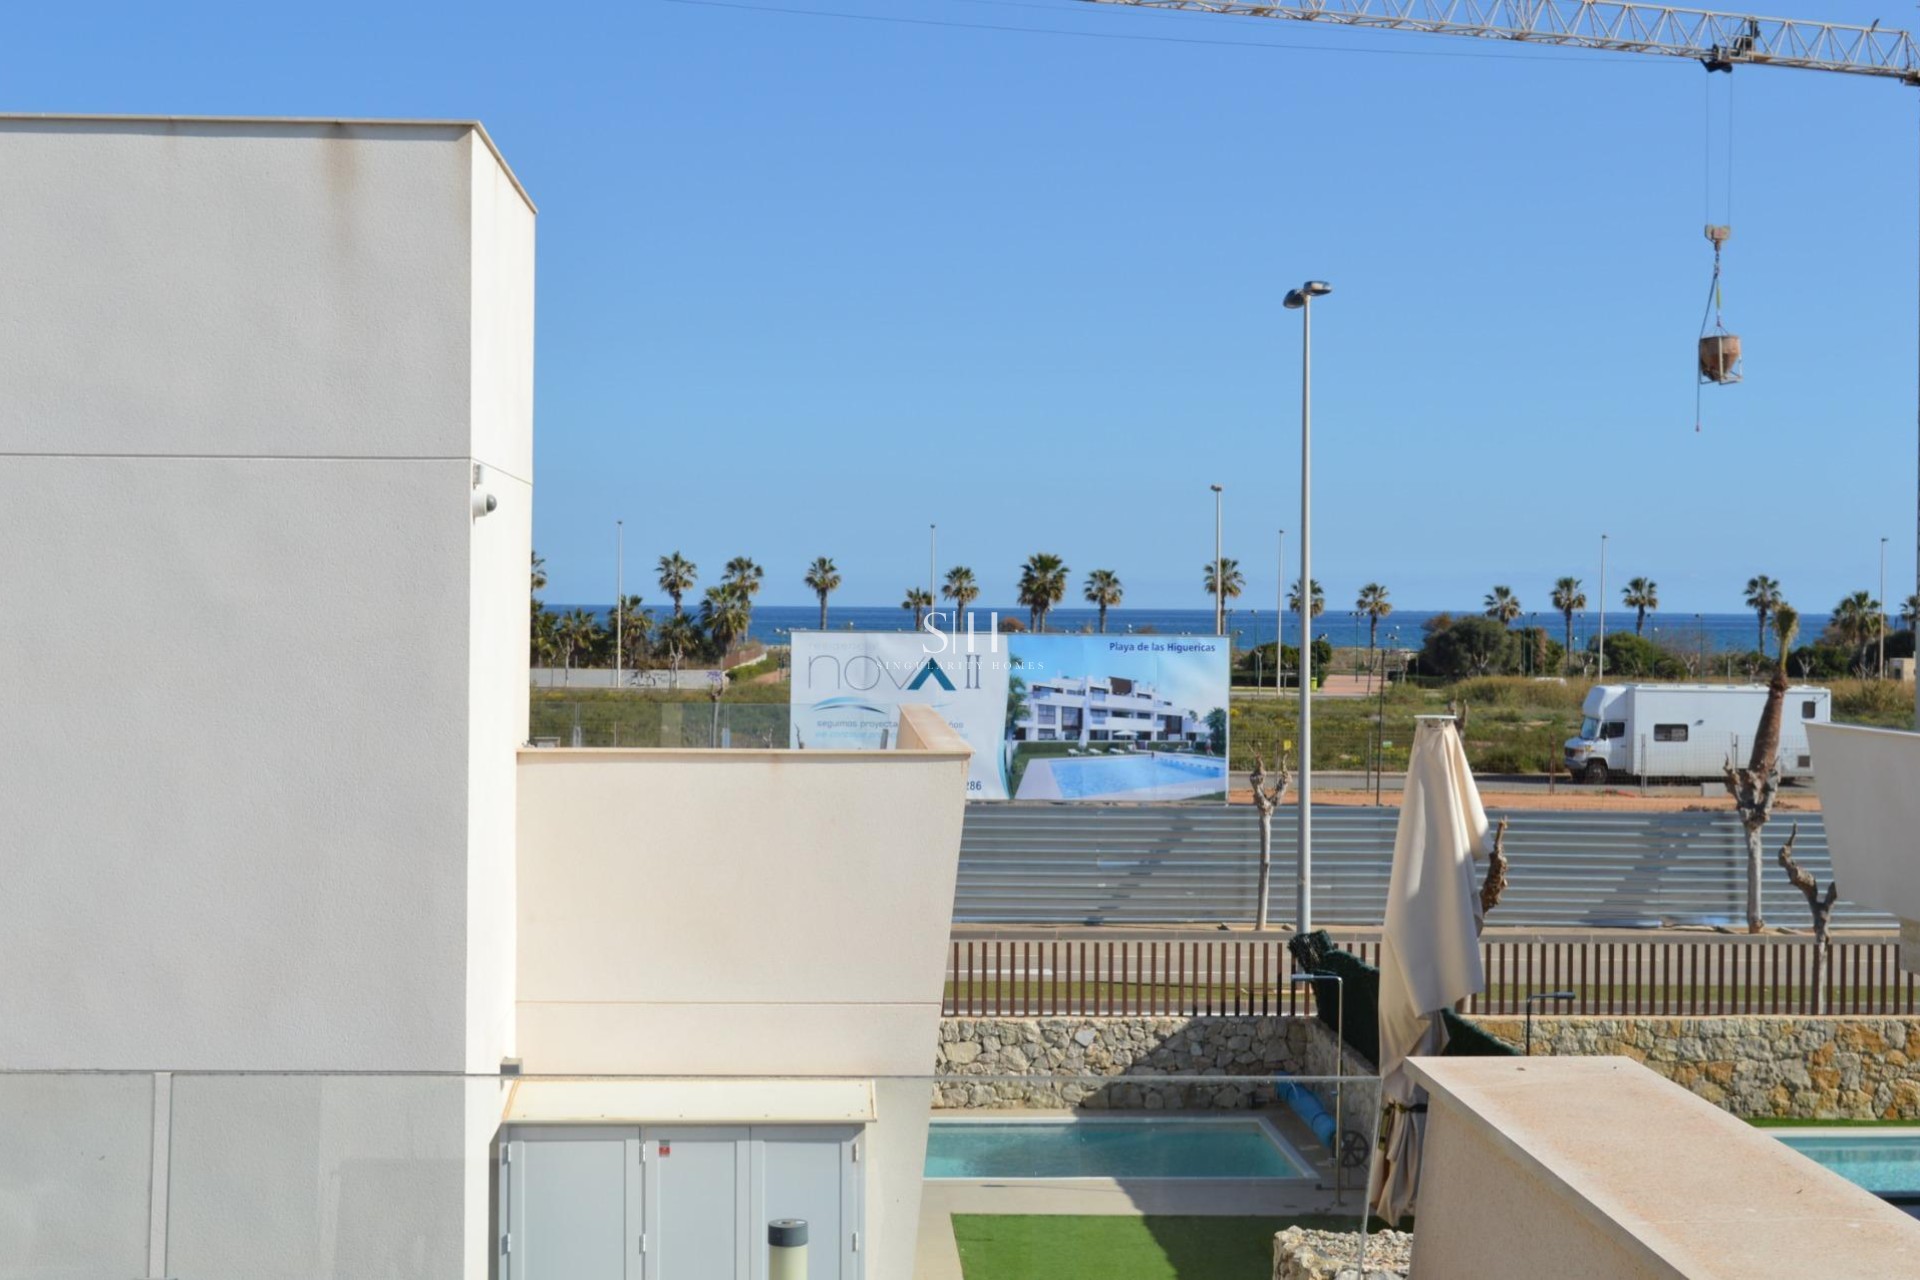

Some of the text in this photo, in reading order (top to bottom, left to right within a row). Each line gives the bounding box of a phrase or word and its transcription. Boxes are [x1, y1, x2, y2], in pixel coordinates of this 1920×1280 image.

[1109, 642, 1216, 653] Playa de las Higuericas
[816, 719, 857, 728] seguimos
[860, 720, 899, 728] proyecta
